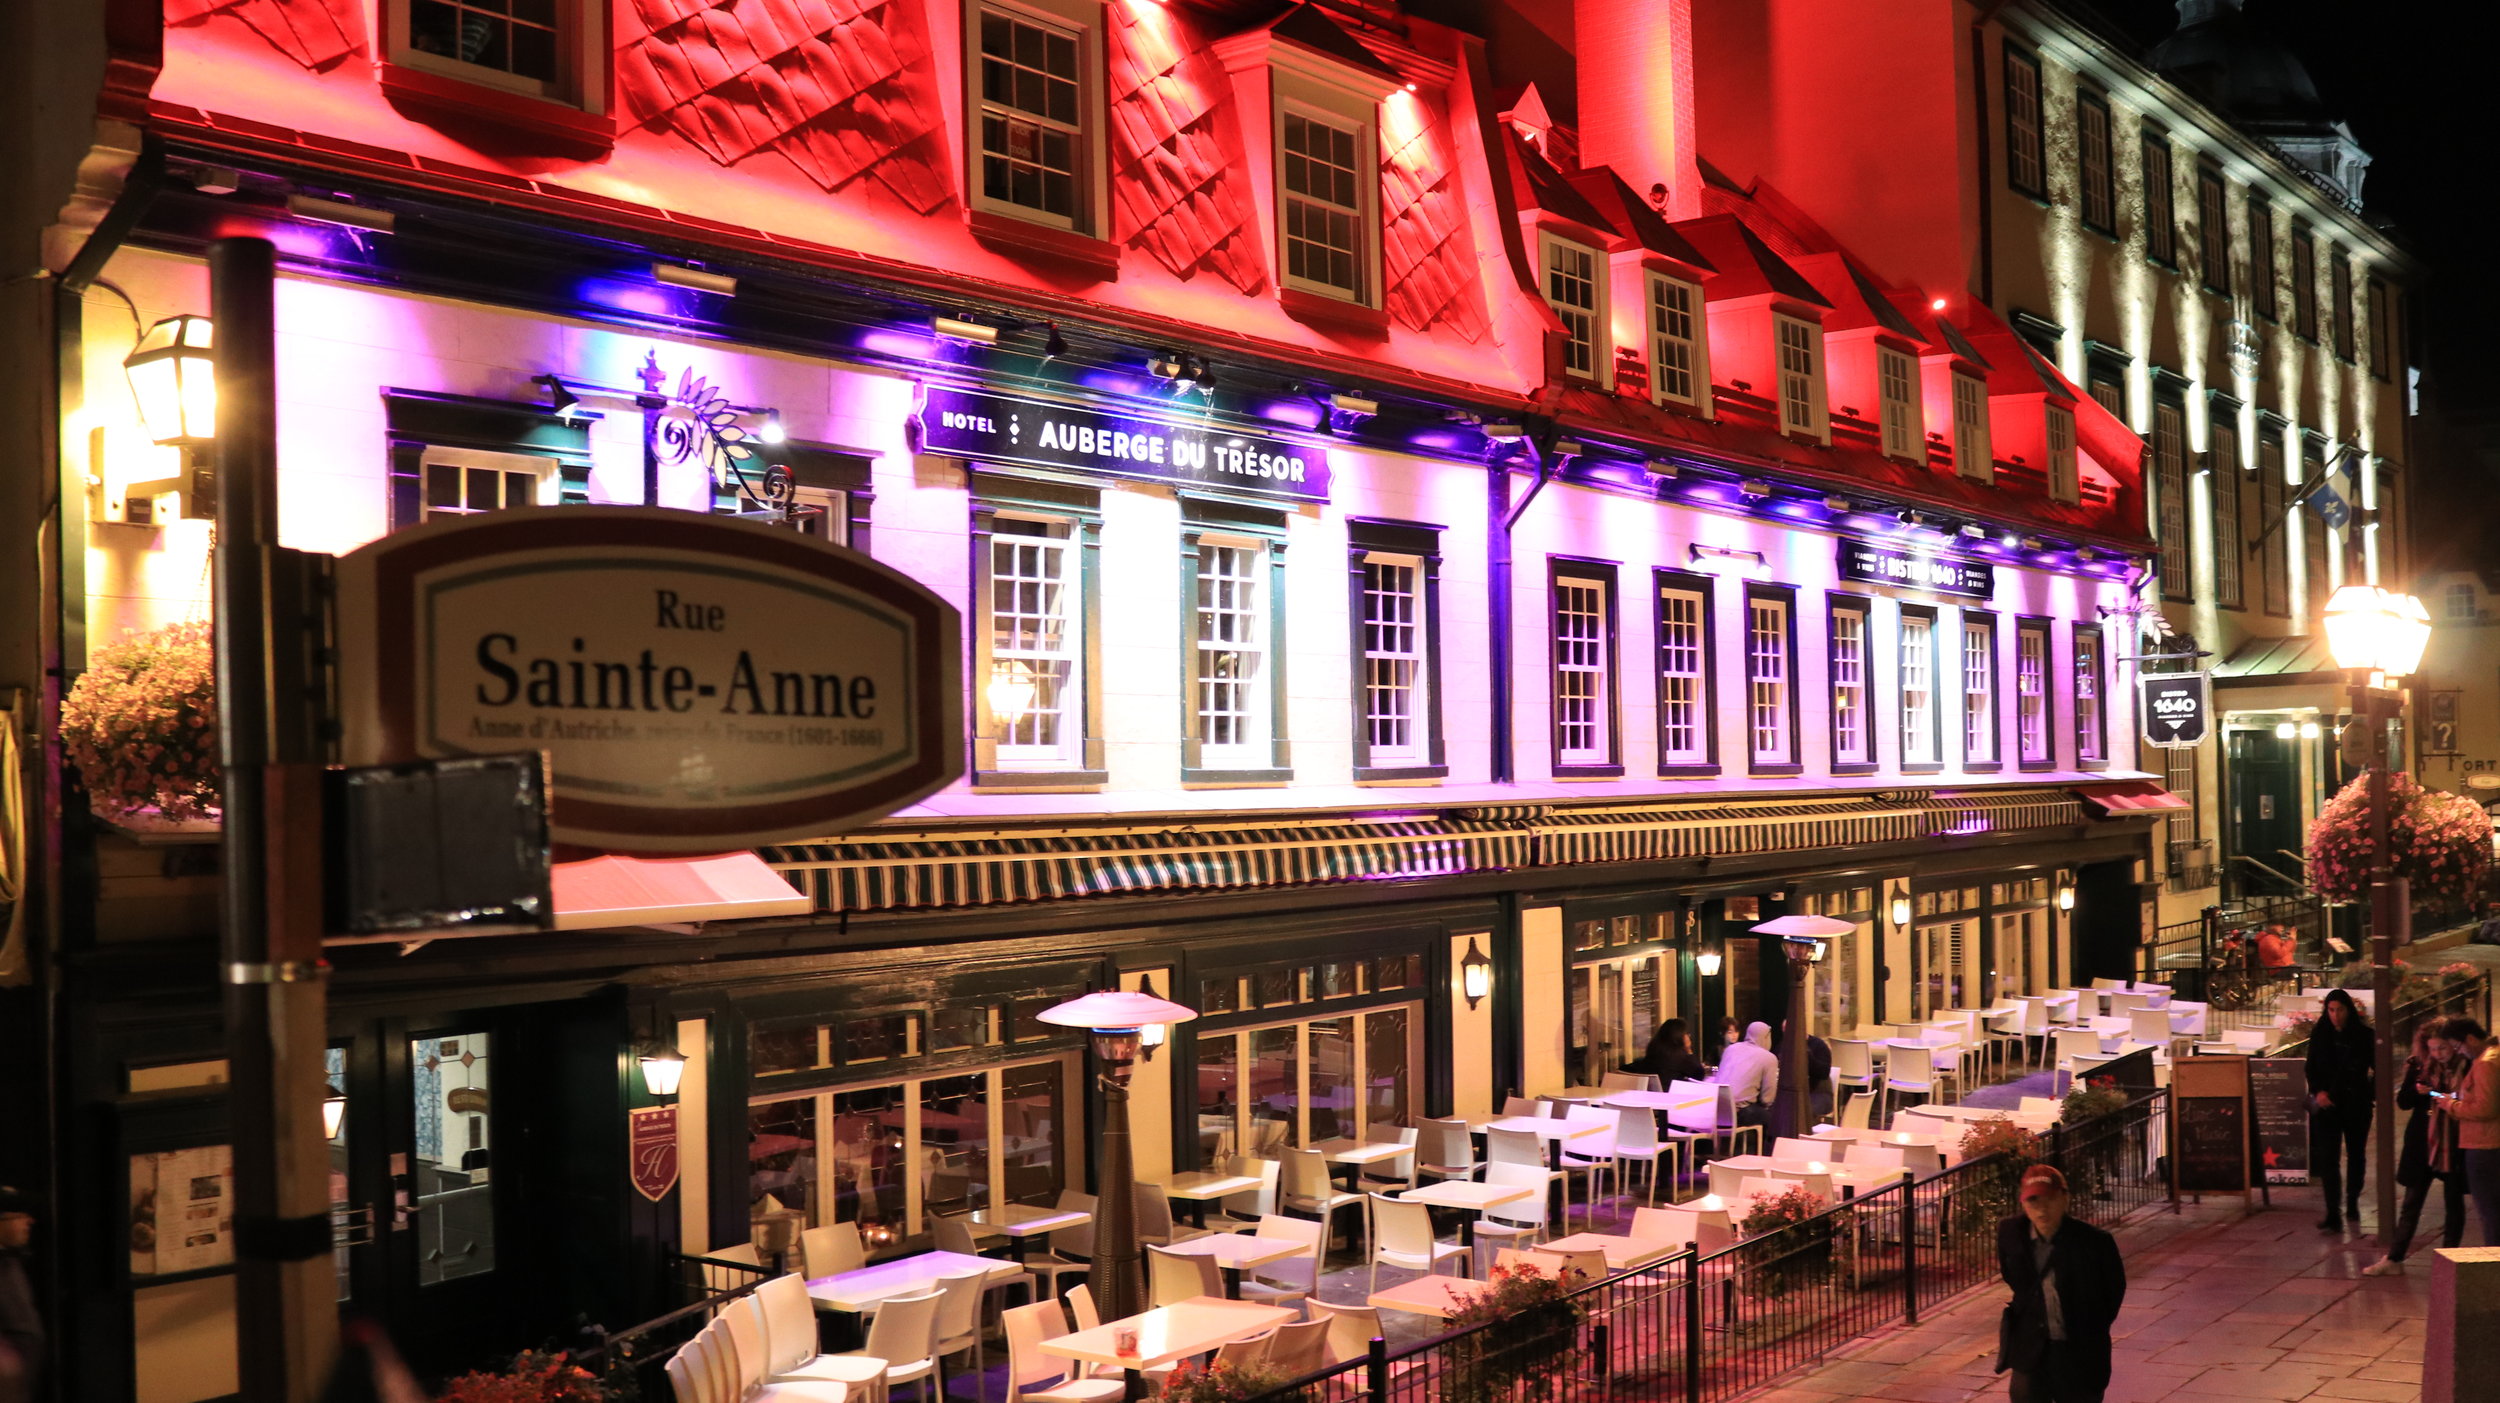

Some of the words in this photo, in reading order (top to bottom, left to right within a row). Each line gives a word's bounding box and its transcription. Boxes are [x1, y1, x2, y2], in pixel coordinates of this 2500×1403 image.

[941, 410, 997, 435] HOTEL
[1038, 420, 1165, 464] AUBERGE
[1172, 440, 1206, 471] DU
[1213, 444, 1306, 484] TRÉSOR
[1887, 557, 1930, 582] BISTRO
[1931, 564, 1956, 586] 1640
[655, 589, 725, 632] Rue
[476, 632, 877, 719] Sainte-Anne
[2153, 698, 2197, 713] 1640
[468, 716, 524, 738] Anne
[726, 723, 784, 745] France
